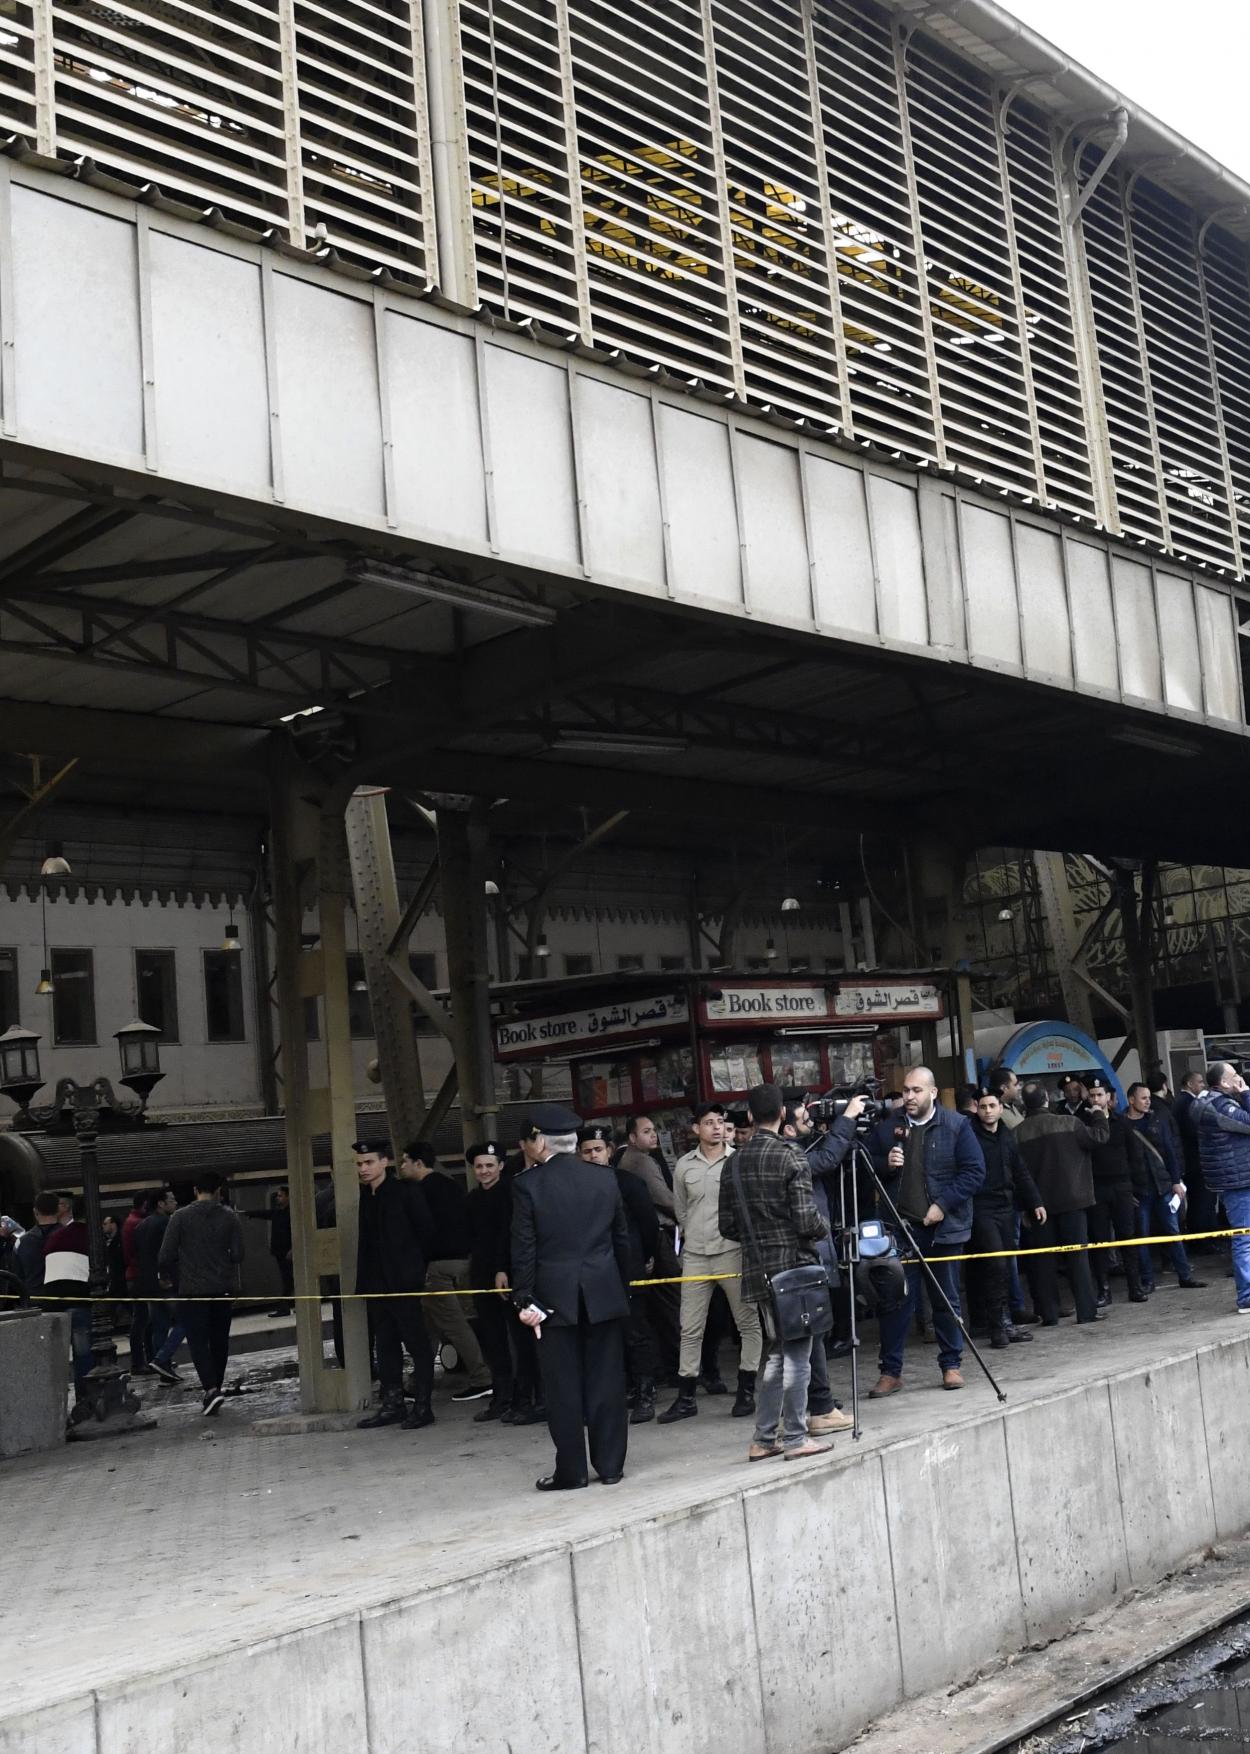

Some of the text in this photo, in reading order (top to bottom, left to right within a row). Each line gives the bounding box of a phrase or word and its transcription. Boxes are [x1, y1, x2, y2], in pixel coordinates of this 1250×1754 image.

[728, 993, 815, 1012] Book store
[499, 1020, 577, 1045] Book store
